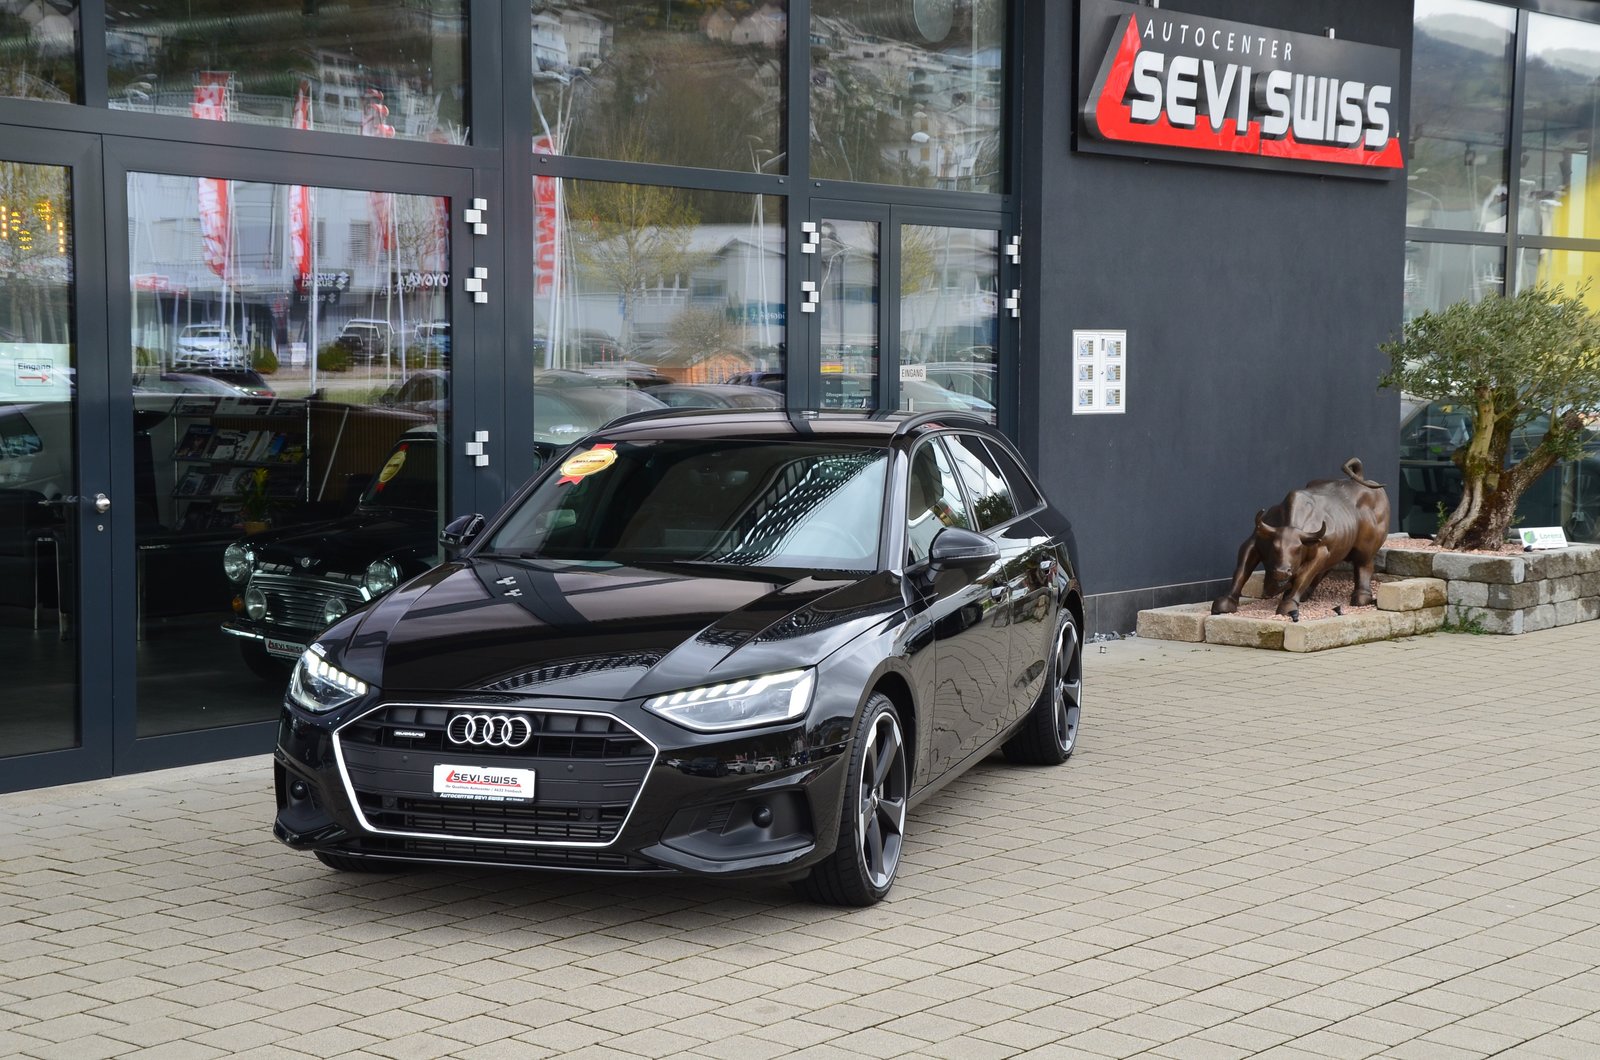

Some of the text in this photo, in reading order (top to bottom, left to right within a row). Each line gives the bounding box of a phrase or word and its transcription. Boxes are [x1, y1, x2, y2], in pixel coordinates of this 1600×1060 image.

[1144, 19, 1292, 61] AUTOCENTER
[1129, 50, 1392, 147] SEVI SWISS
[901, 368, 924, 378] EINGANG
[453, 773, 518, 785] SEVI SWISS
